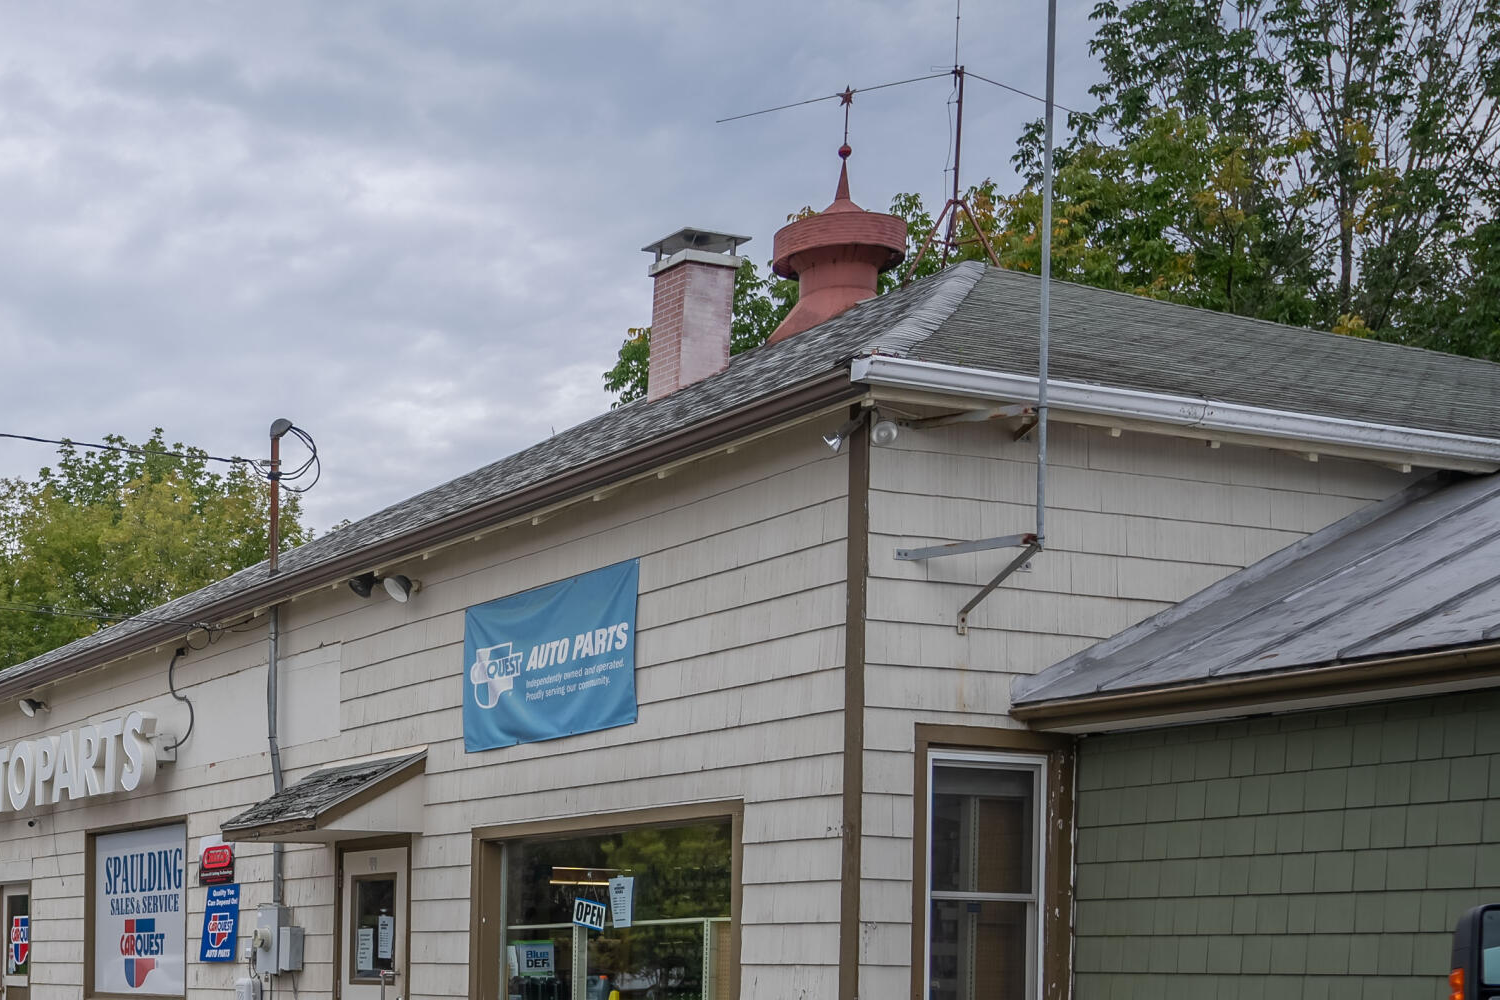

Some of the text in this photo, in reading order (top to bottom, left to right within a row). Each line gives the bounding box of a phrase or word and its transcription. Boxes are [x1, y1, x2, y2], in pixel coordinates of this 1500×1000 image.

[526, 622, 628, 672] AUTO PARTS
[526, 673, 562, 688] Independently
[564, 668, 583, 680] owned
[526, 690, 544, 702] Proudly
[545, 685, 565, 697] serving
[566, 683, 577, 692] our
[105, 848, 183, 895] SPAULDING
[213, 889, 226, 897] Quality
[216, 898, 230, 907] Depend
[111, 894, 179, 916] SALES & SERVICE
[576, 902, 603, 926] OPEN
[11, 927, 28, 943] CARQU
[120, 933, 165, 957] CARQUEST
[206, 949, 230, 958] AUTO PARTS
[526, 950, 549, 959] Blue
